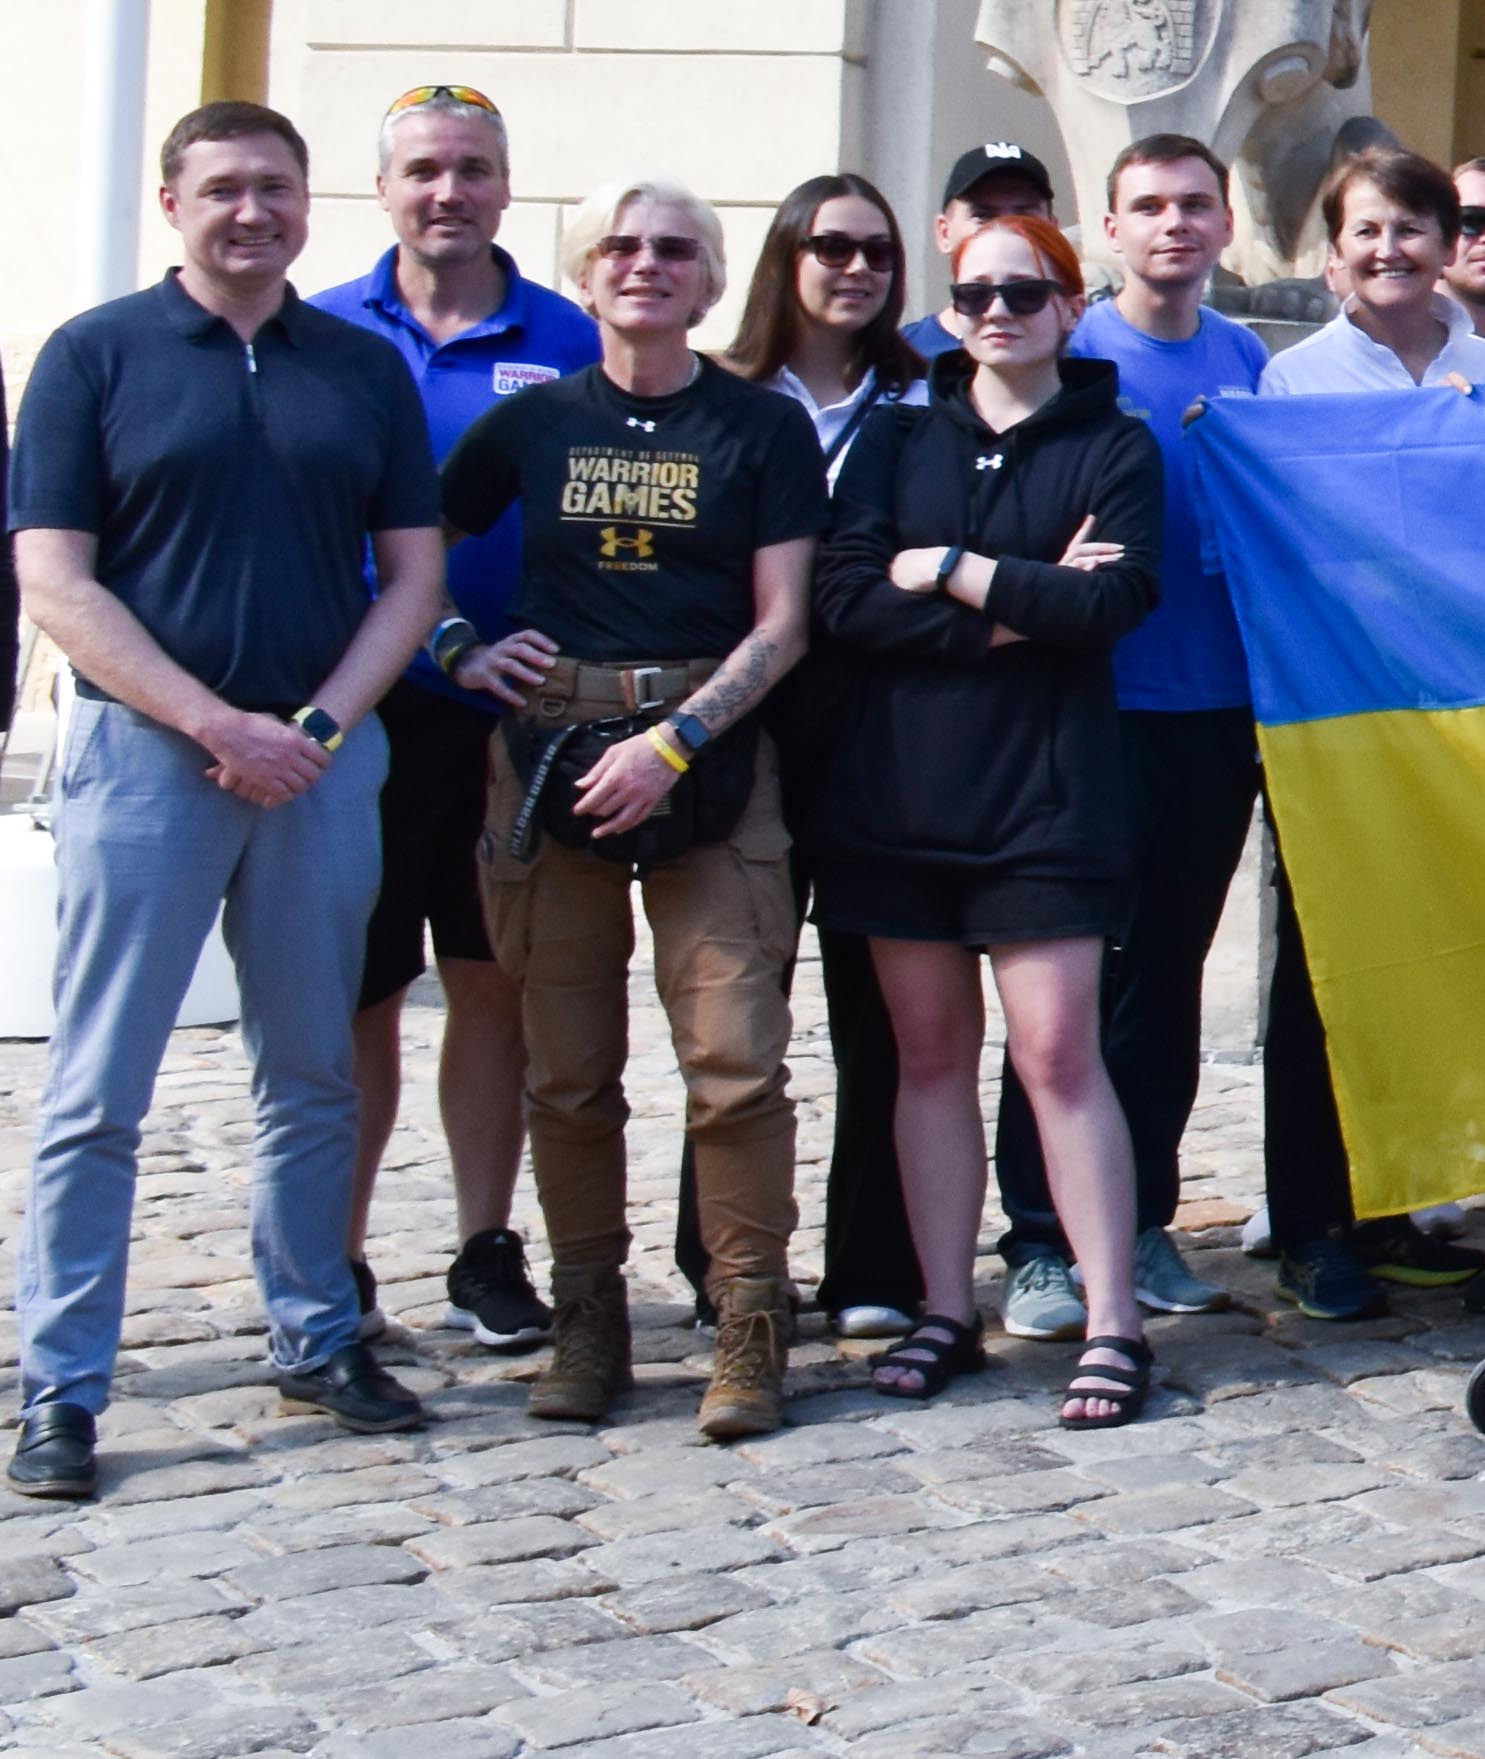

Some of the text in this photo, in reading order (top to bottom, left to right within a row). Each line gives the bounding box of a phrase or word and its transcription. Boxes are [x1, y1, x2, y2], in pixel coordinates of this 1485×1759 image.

[568, 457, 699, 489] WARRIOR
[561, 481, 698, 521] GAMES
[597, 561, 659, 572] FREEDOM
